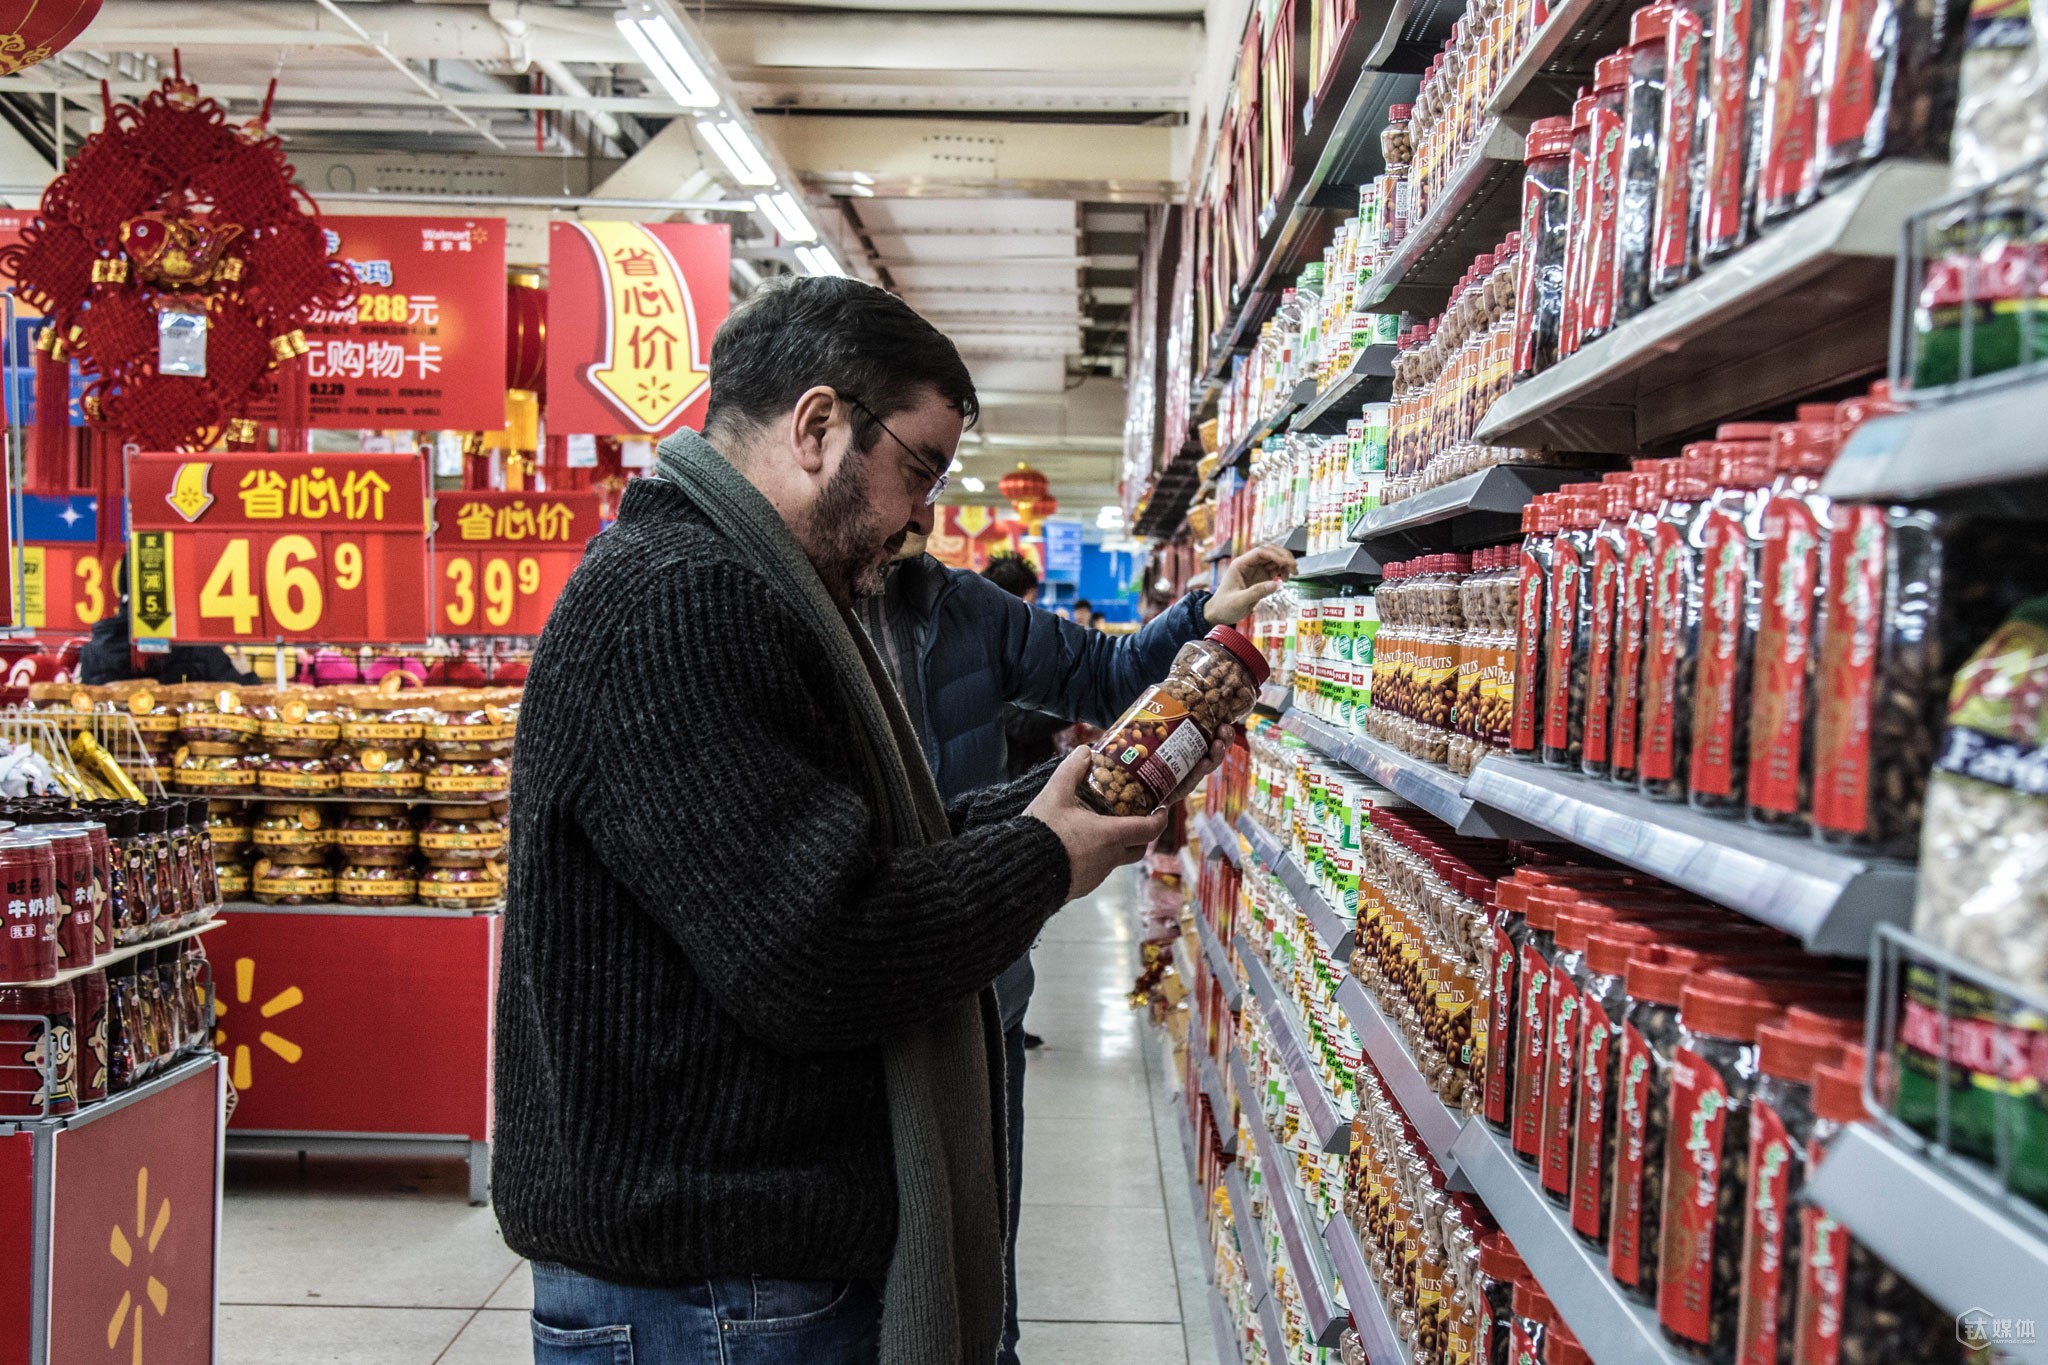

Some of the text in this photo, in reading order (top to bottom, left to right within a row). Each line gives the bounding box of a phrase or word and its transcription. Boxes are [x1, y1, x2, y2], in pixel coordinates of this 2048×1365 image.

[614, 248, 679, 371] 省心价
[238, 467, 391, 521] 省心价
[457, 501, 574, 541] 省心价
[1497, 667, 1515, 685] PEA
